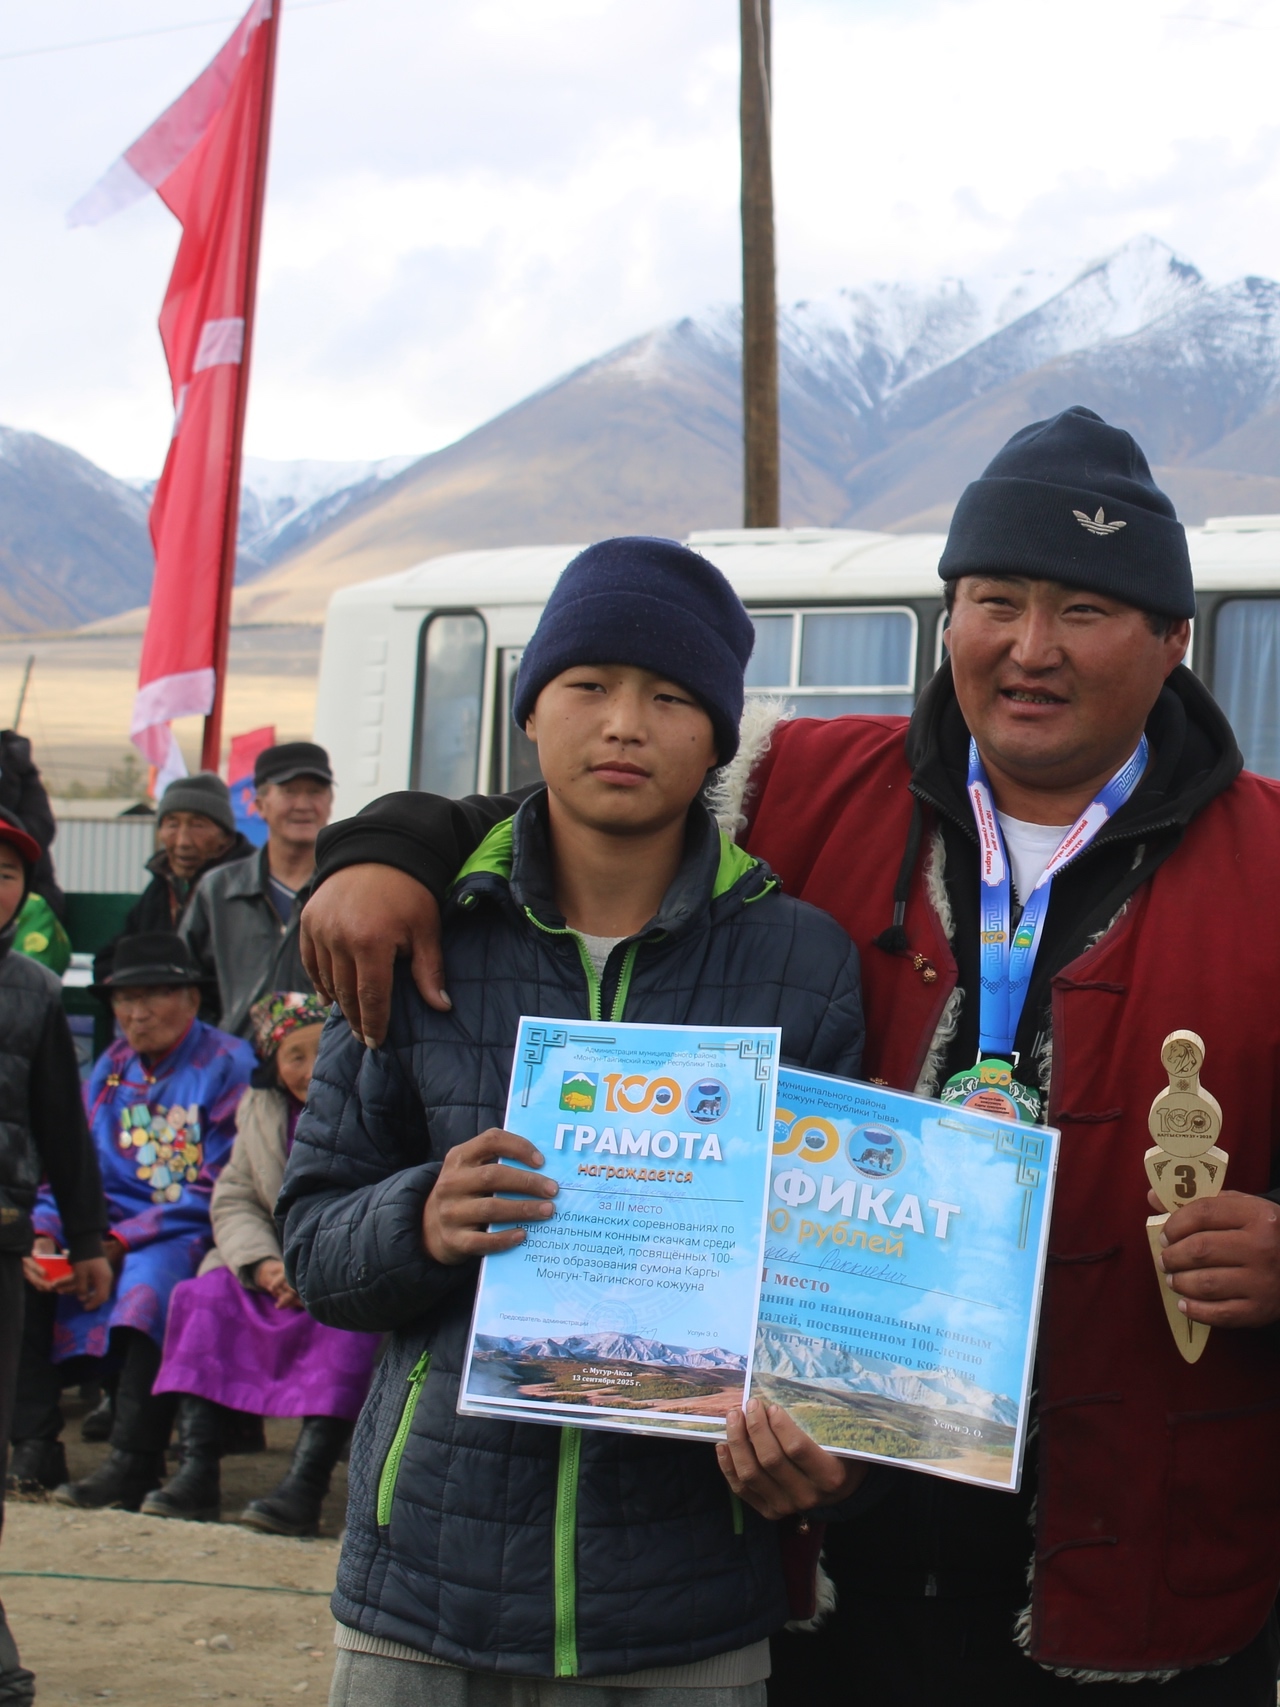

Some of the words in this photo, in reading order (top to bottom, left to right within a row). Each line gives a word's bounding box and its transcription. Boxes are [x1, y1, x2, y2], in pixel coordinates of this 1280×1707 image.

[985, 850, 993, 875] Каргы
[585, 1046, 638, 1056] Администрация
[639, 1050, 693, 1059] муниципального
[668, 1060, 705, 1068] Республики
[603, 1073, 682, 1115] 100
[782, 1091, 815, 1105] кожуун
[817, 1099, 870, 1117] Республики
[872, 1111, 900, 1123] Тыва»
[854, 1097, 887, 1110] района
[1156, 1107, 1212, 1134] 100
[553, 1123, 723, 1161] ГРАМОТА
[577, 1163, 693, 1184] награждается
[1174, 1164, 1197, 1199] 3
[599, 1201, 612, 1211] за
[628, 1204, 663, 1214] место
[773, 1168, 961, 1239] ФИКАТ
[632, 1219, 718, 1233] соревнованиях
[721, 1225, 735, 1234] по
[799, 1219, 905, 1258] рублей
[519, 1238, 570, 1251] зрослых
[572, 1242, 625, 1257] лошадей,
[629, 1249, 707, 1262] посвящённых
[711, 1252, 734, 1264] 100-
[605, 1231, 650, 1243] конным
[653, 1235, 700, 1247] скачкам
[703, 1239, 736, 1249] среди
[524, 1252, 561, 1265] летию
[563, 1255, 638, 1271] образования
[640, 1264, 682, 1276] сумона
[685, 1265, 720, 1279] Каргы
[536, 1267, 654, 1287] Монгун-Тайгинского
[656, 1280, 705, 1292] кожууна
[774, 1273, 830, 1293] место
[799, 1298, 817, 1310] по
[820, 1302, 932, 1334] национальным
[935, 1326, 993, 1350] конным
[756, 1326, 913, 1367] Монгун-Тайгинского
[917, 1357, 976, 1383] кожууна
[806, 1319, 907, 1347] посвященном
[911, 1337, 983, 1366] 100-летию
[582, 1376, 615, 1385] сентября
[616, 1378, 635, 1386] 2025
